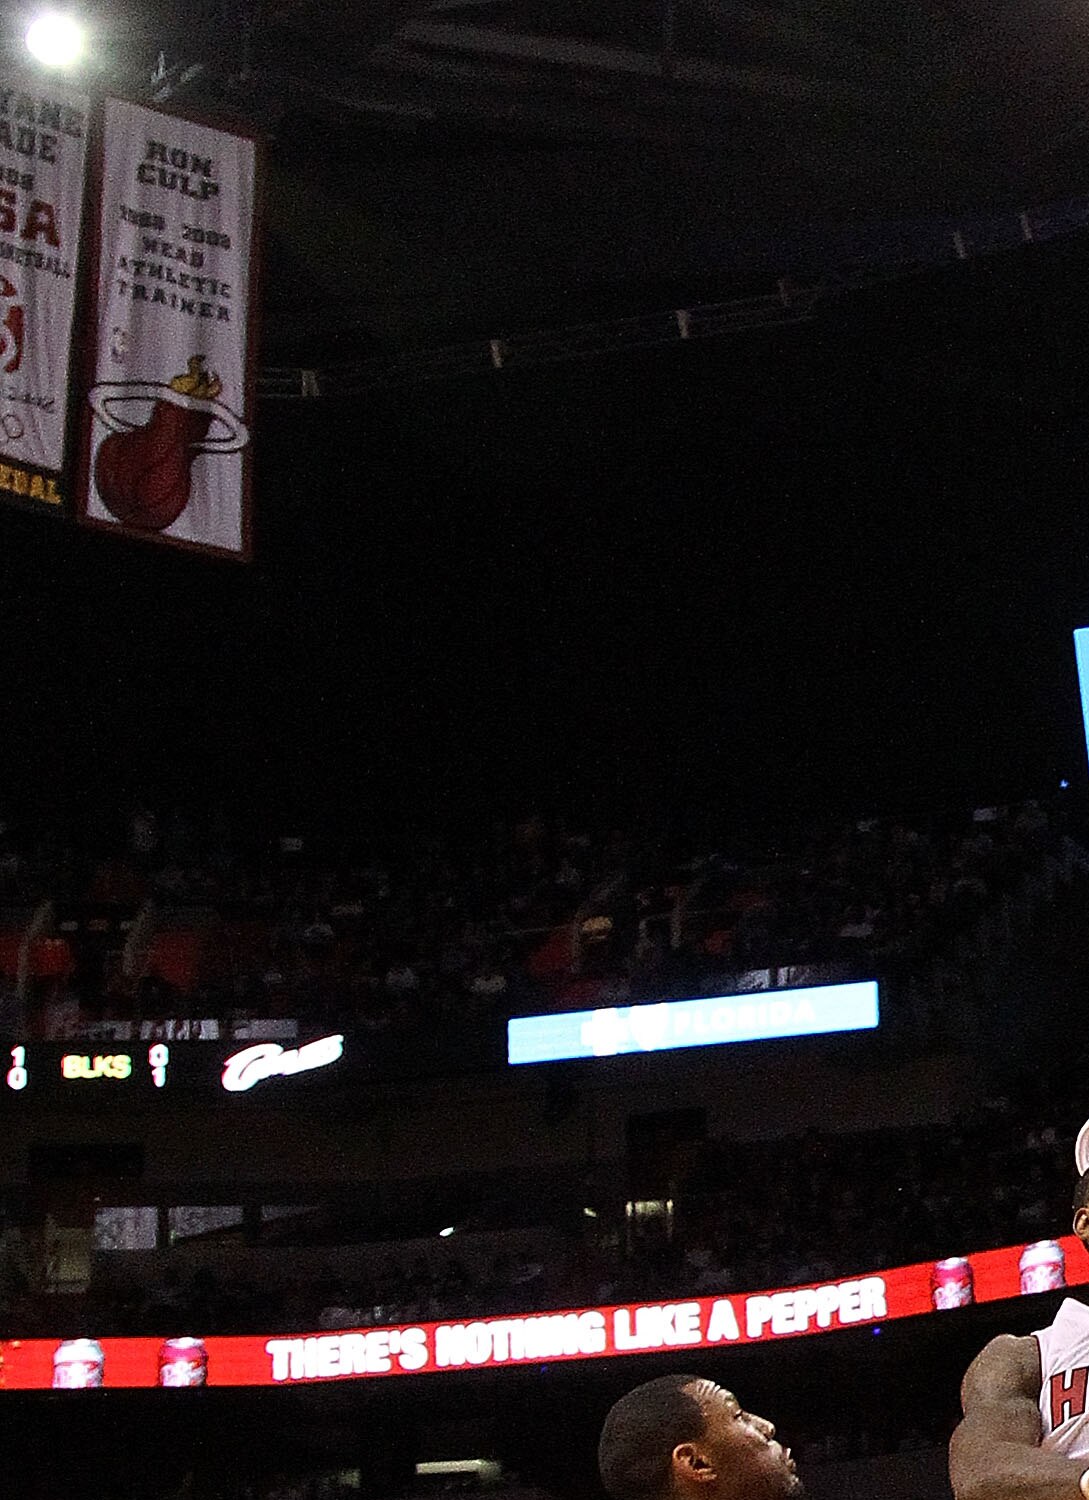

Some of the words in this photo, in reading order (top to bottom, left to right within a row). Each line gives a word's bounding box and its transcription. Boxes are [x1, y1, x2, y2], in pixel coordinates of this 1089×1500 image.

[147, 140, 212, 177] RON
[137, 163, 220, 201] CULP
[61, 1054, 132, 1079] BLKS
[265, 1327, 428, 1381] THERE'S
[434, 1310, 606, 1367] NOTHING
[613, 1301, 702, 1351] LIKE
[706, 1299, 740, 1341] A
[745, 1276, 888, 1338] PEPPER
